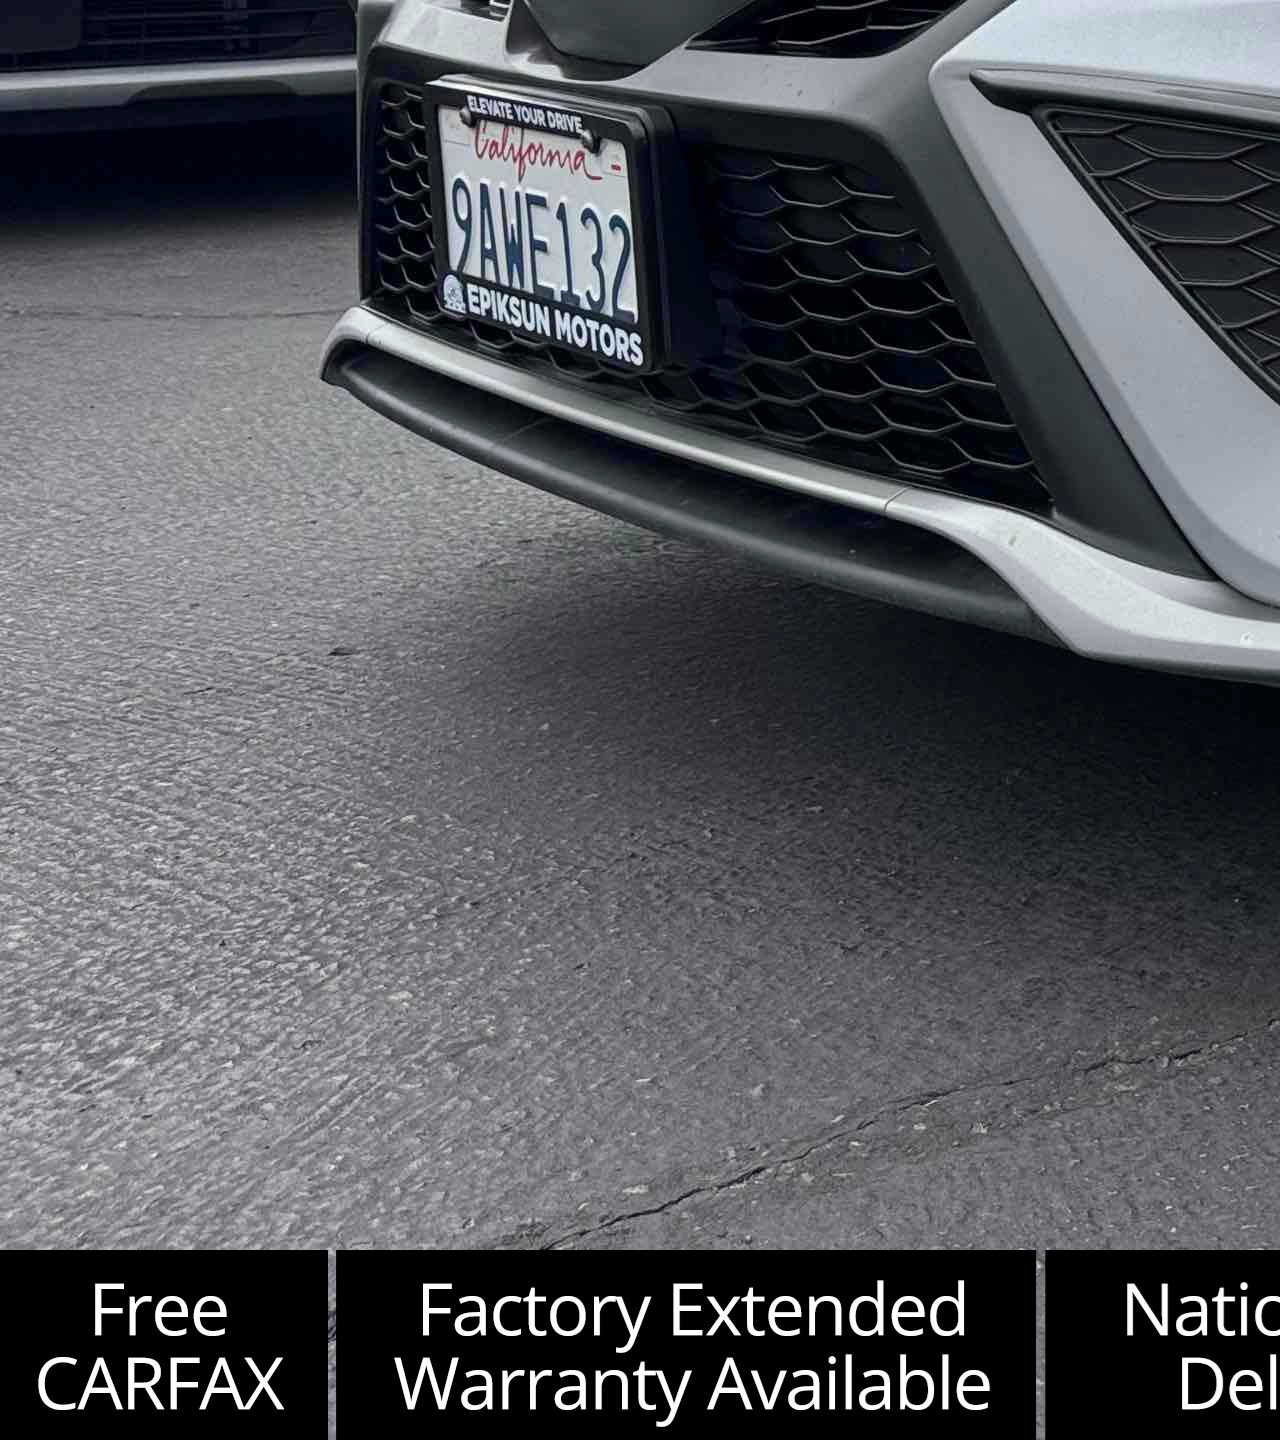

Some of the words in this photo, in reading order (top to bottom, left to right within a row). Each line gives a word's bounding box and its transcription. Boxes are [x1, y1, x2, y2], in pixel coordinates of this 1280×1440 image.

[467, 95, 514, 120] ELEVATE
[513, 103, 548, 128] YOUR
[546, 110, 585, 135] DRIVE
[475, 120, 602, 182] California
[451, 177, 638, 324] 9AWE132
[467, 284, 550, 337] EPIKSUN
[555, 312, 643, 366] MOTORS
